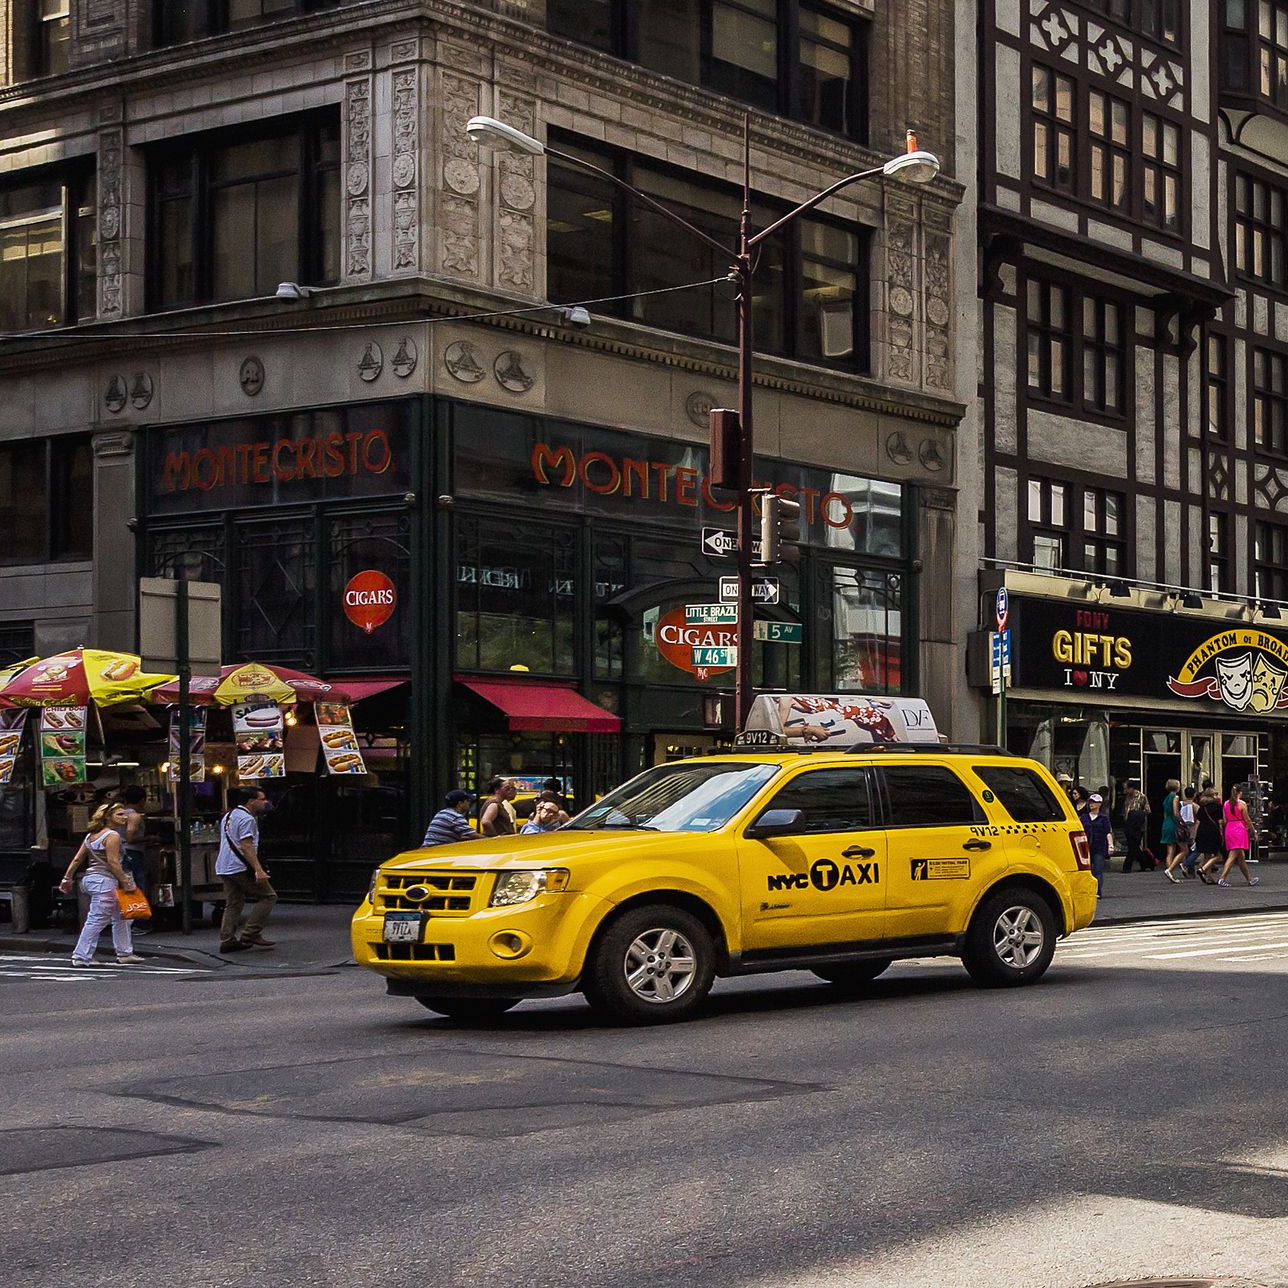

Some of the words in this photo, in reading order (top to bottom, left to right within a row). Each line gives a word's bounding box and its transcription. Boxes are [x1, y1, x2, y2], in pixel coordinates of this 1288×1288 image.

[345, 589, 393, 606] CIGARS
[725, 585, 737, 595] ON
[686, 606, 708, 618] LITTLE
[710, 605, 738, 617] BRAZIL
[771, 624, 781, 639] 5
[693, 649, 703, 663] W
[705, 648, 719, 664] 46
[720, 649, 728, 658] ST
[1052, 629, 1132, 669] GIFTS
[1187, 632, 1238, 675] PHANTOM
[1064, 668, 1073, 686] I
[1089, 671, 1119, 690] NY
[746, 732, 768, 744] 9V12
[970, 826, 999, 837] 9V12
[768, 873, 809, 891] NYC
[811, 860, 879, 890] TAXI
